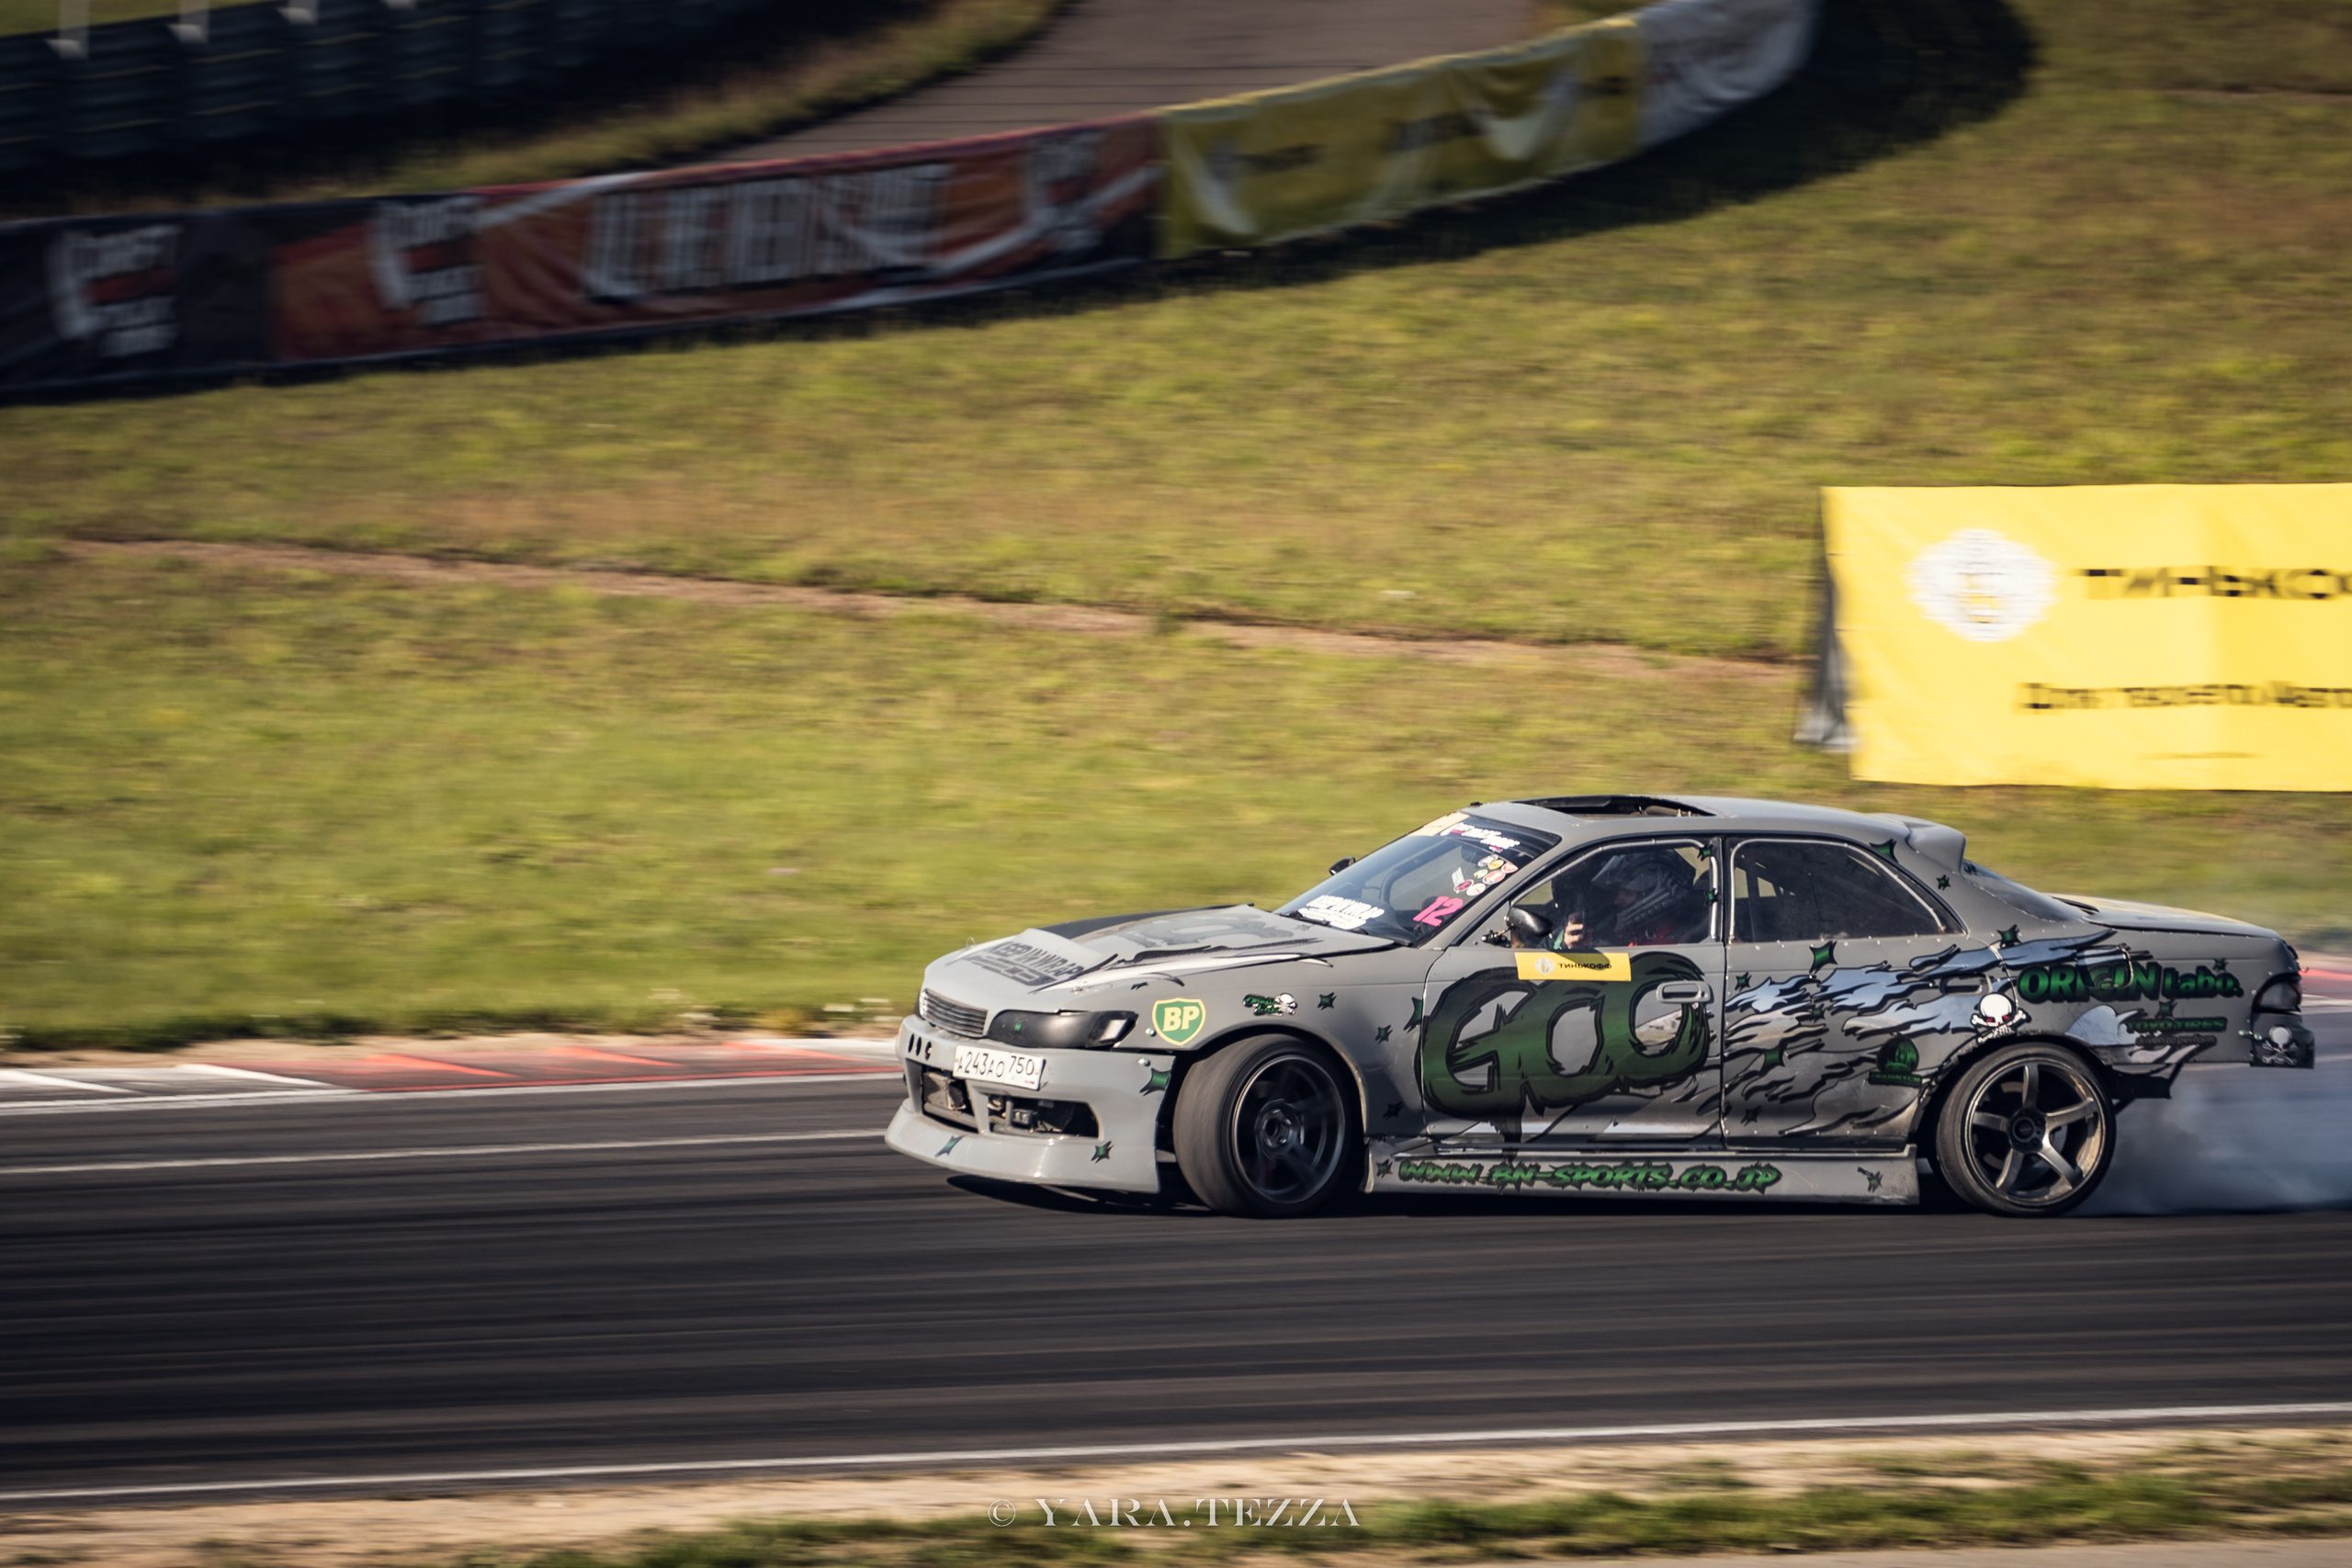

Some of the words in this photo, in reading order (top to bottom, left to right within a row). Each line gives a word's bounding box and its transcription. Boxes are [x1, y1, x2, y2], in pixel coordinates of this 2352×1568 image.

[1412, 896, 1464, 927] 12
[2019, 963, 2162, 1001] ORIGIN
[2164, 966, 2244, 998] Labo.
[1162, 1005, 1200, 1032] BP
[2126, 1019, 2174, 1031] TOYO
[2175, 1017, 2226, 1030] TIRES
[1009, 1055, 1035, 1076] 750
